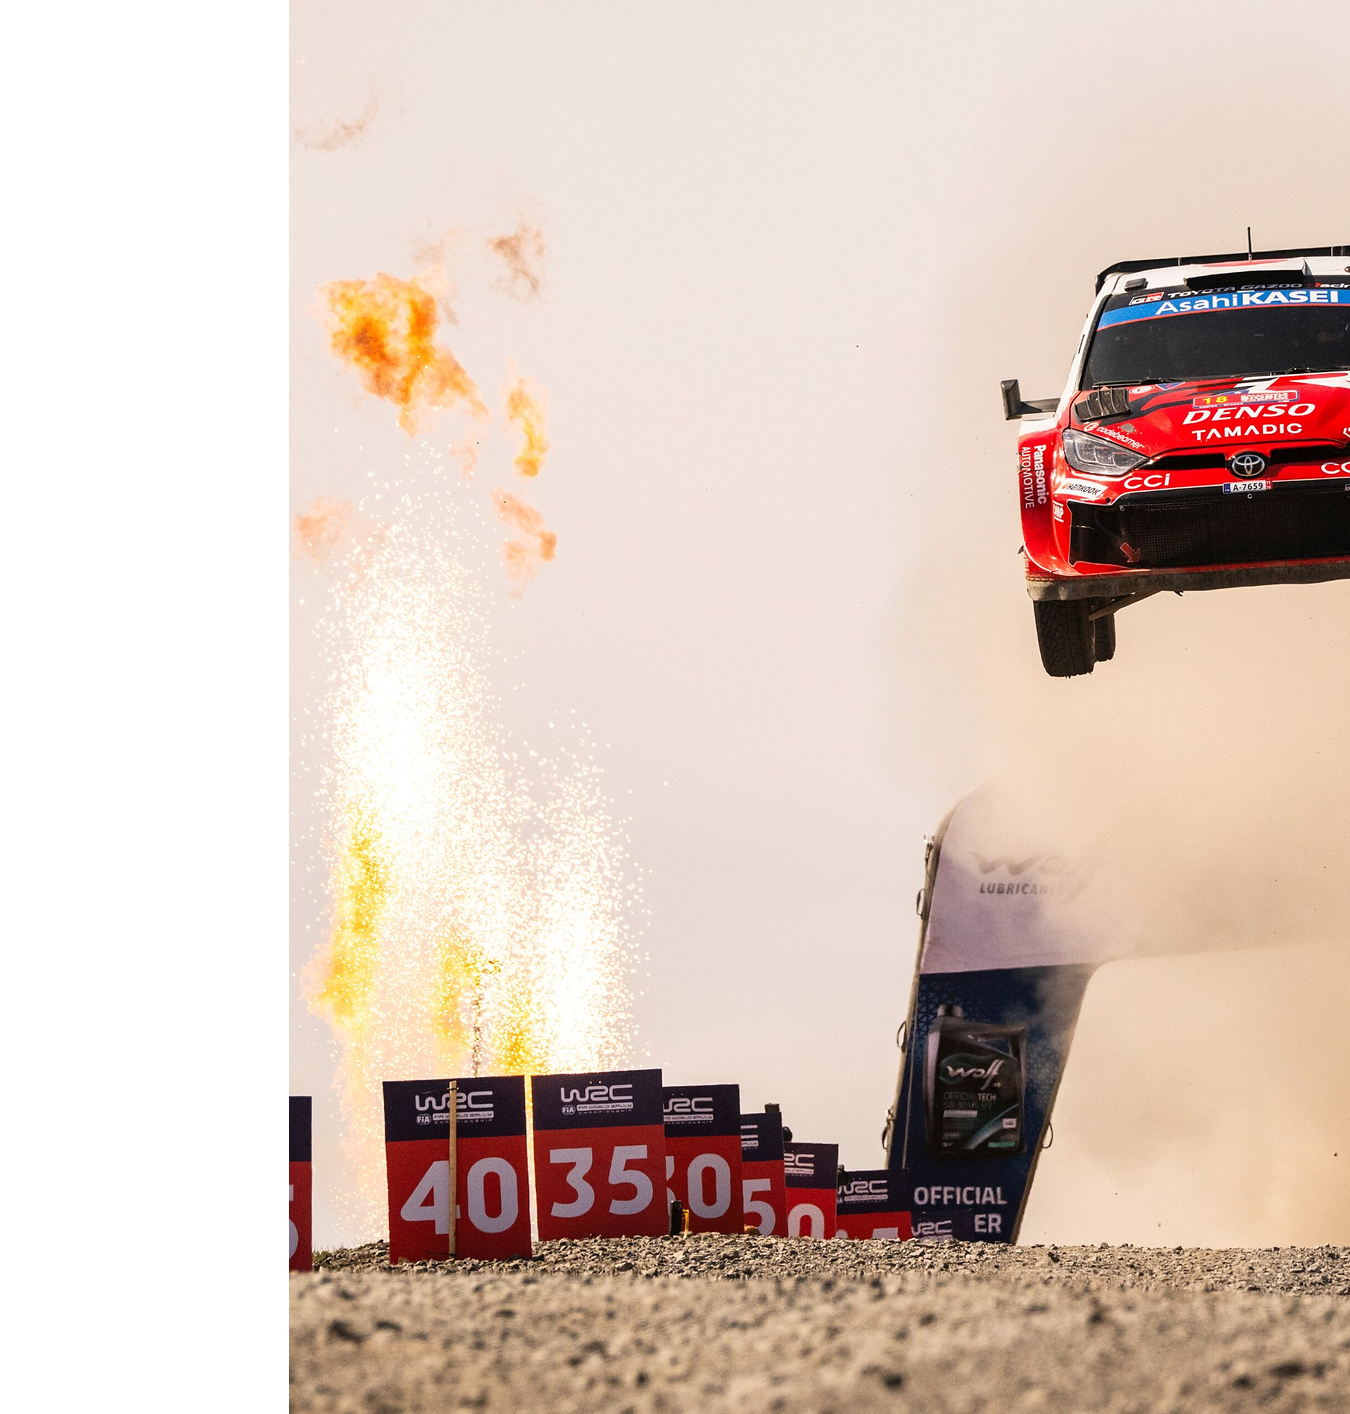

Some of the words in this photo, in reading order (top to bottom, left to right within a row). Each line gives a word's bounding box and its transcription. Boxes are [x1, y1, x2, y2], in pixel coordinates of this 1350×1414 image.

[1167, 286, 1235, 298] TOYOTA
[1203, 395, 1228, 405] 18
[1182, 402, 1316, 425] DENSO
[1191, 422, 1303, 441] TAMADIC
[1022, 446, 1035, 509] AUTOMOTIVE
[1034, 444, 1050, 505] Panasonic
[1232, 482, 1263, 492] A-7659
[561, 1084, 633, 1102] WRC
[550, 1145, 654, 1217] 35
[401, 1157, 519, 1234] 40
[914, 1186, 1008, 1205] OFFICIAL
